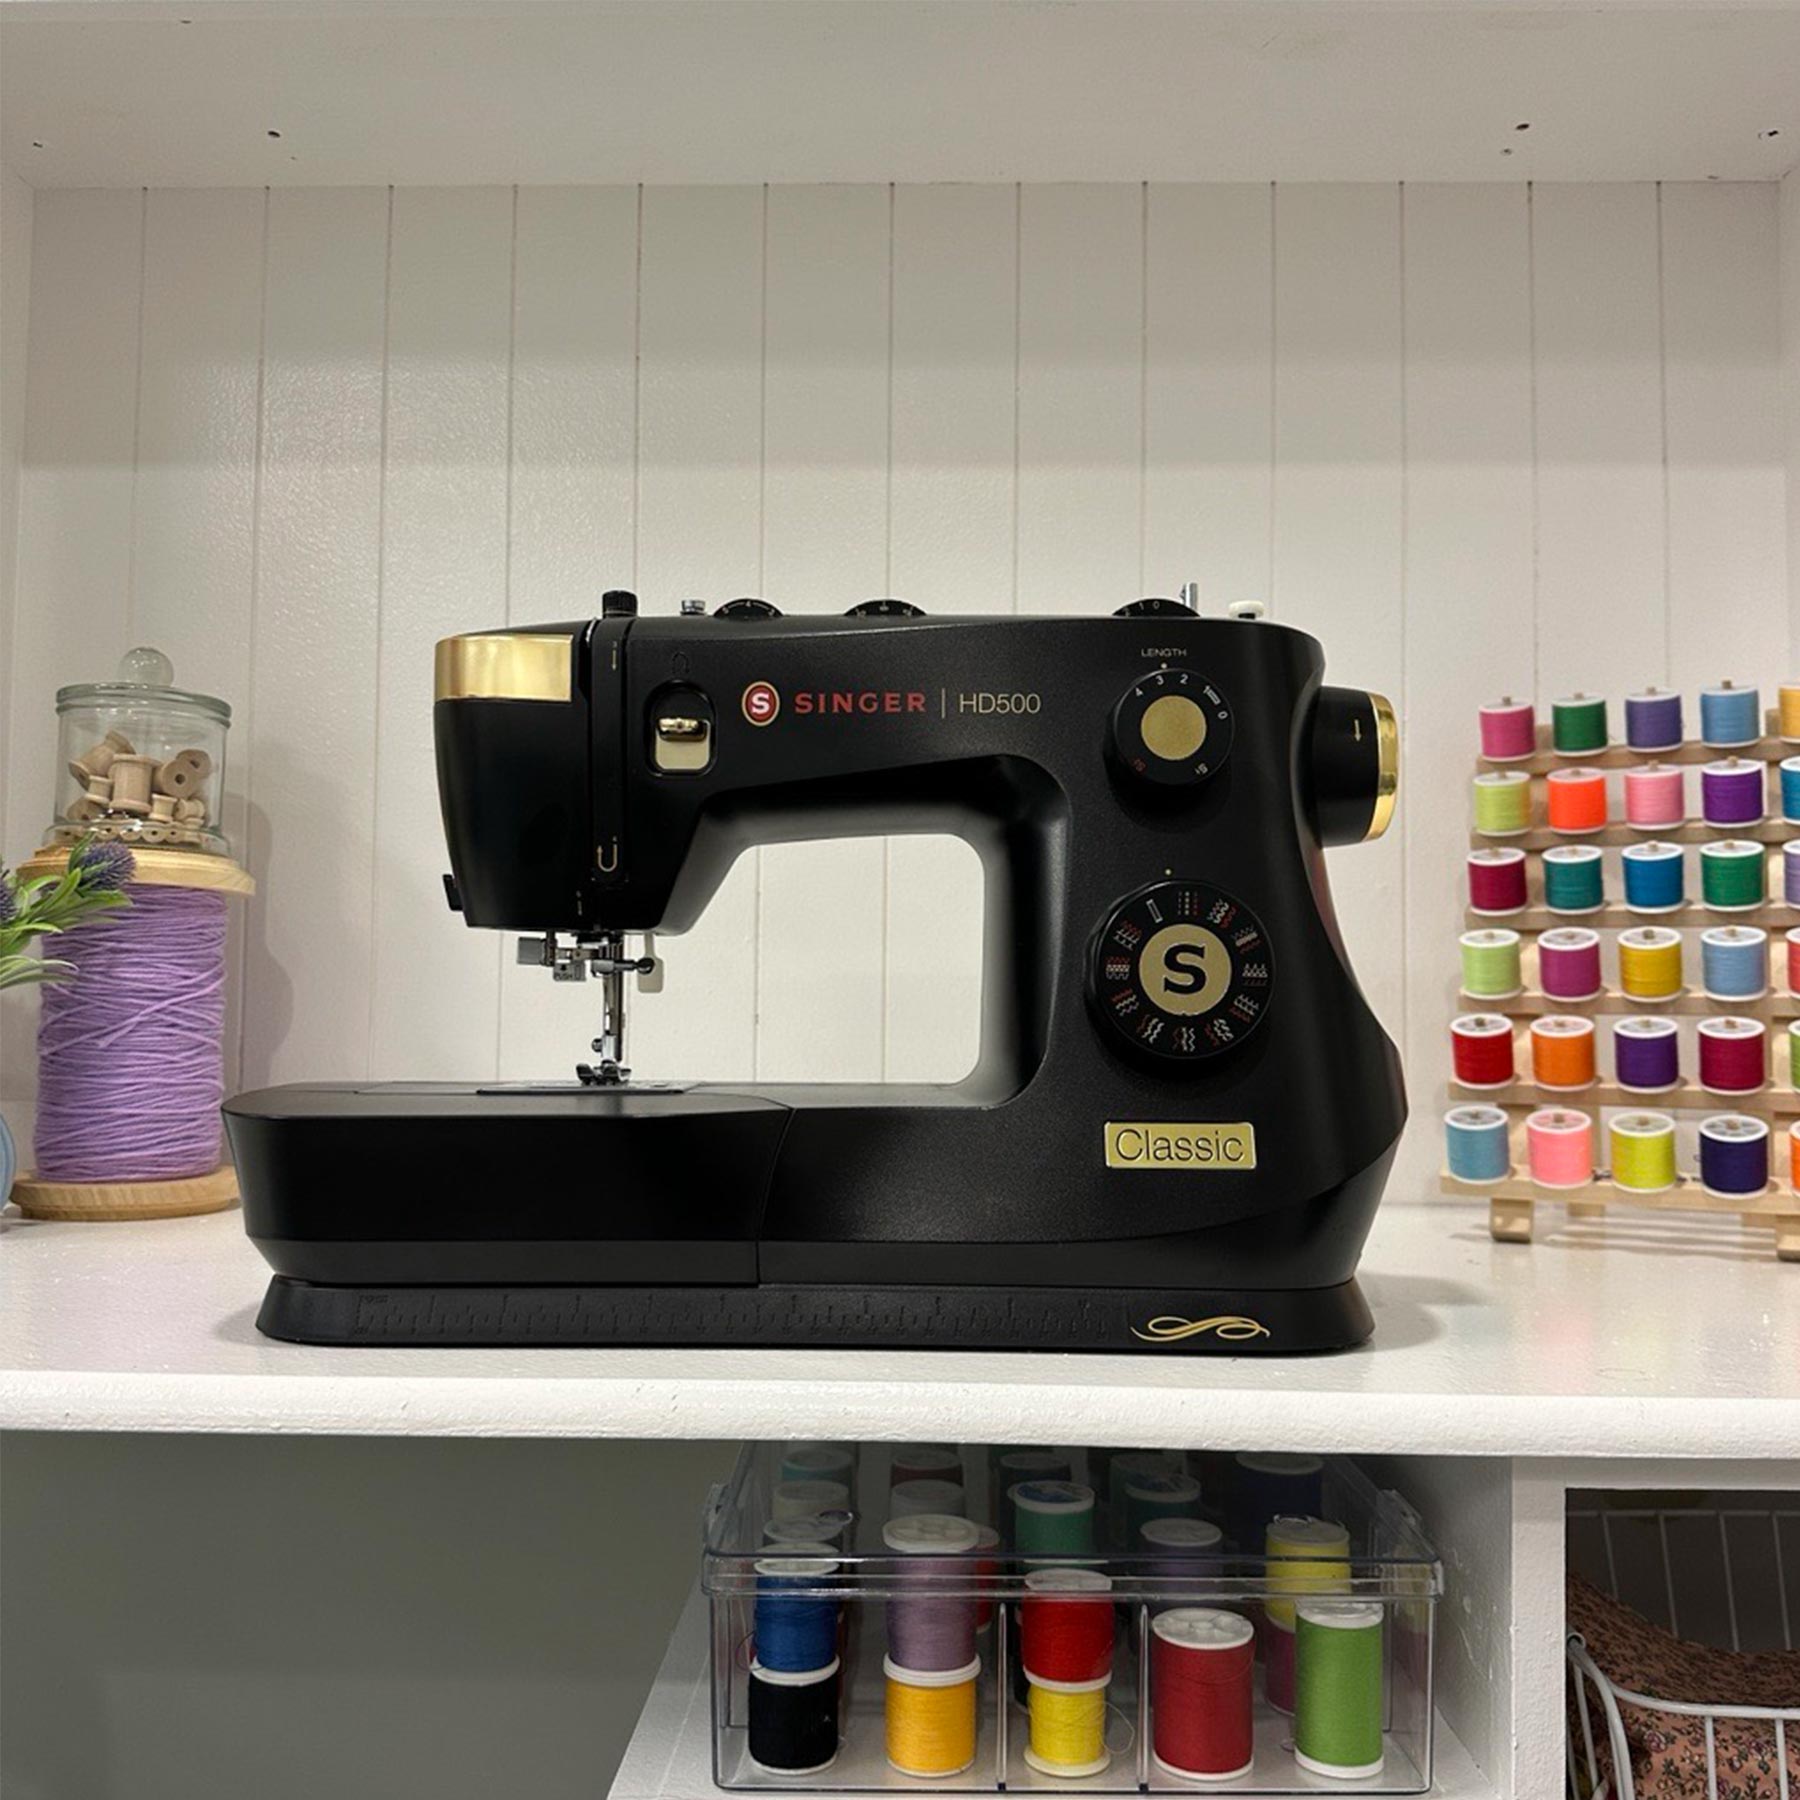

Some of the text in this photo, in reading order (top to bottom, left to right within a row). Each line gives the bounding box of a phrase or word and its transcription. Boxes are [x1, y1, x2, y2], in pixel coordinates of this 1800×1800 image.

[1141, 648, 1187, 657] LENGTH
[795, 693, 1041, 713] SINGER HD500
[1155, 675, 1164, 685] 3
[1180, 674, 1188, 684] 2
[1217, 711, 1228, 719] 0
[1163, 943, 1207, 995] S
[1115, 1128, 1244, 1162] Classic
